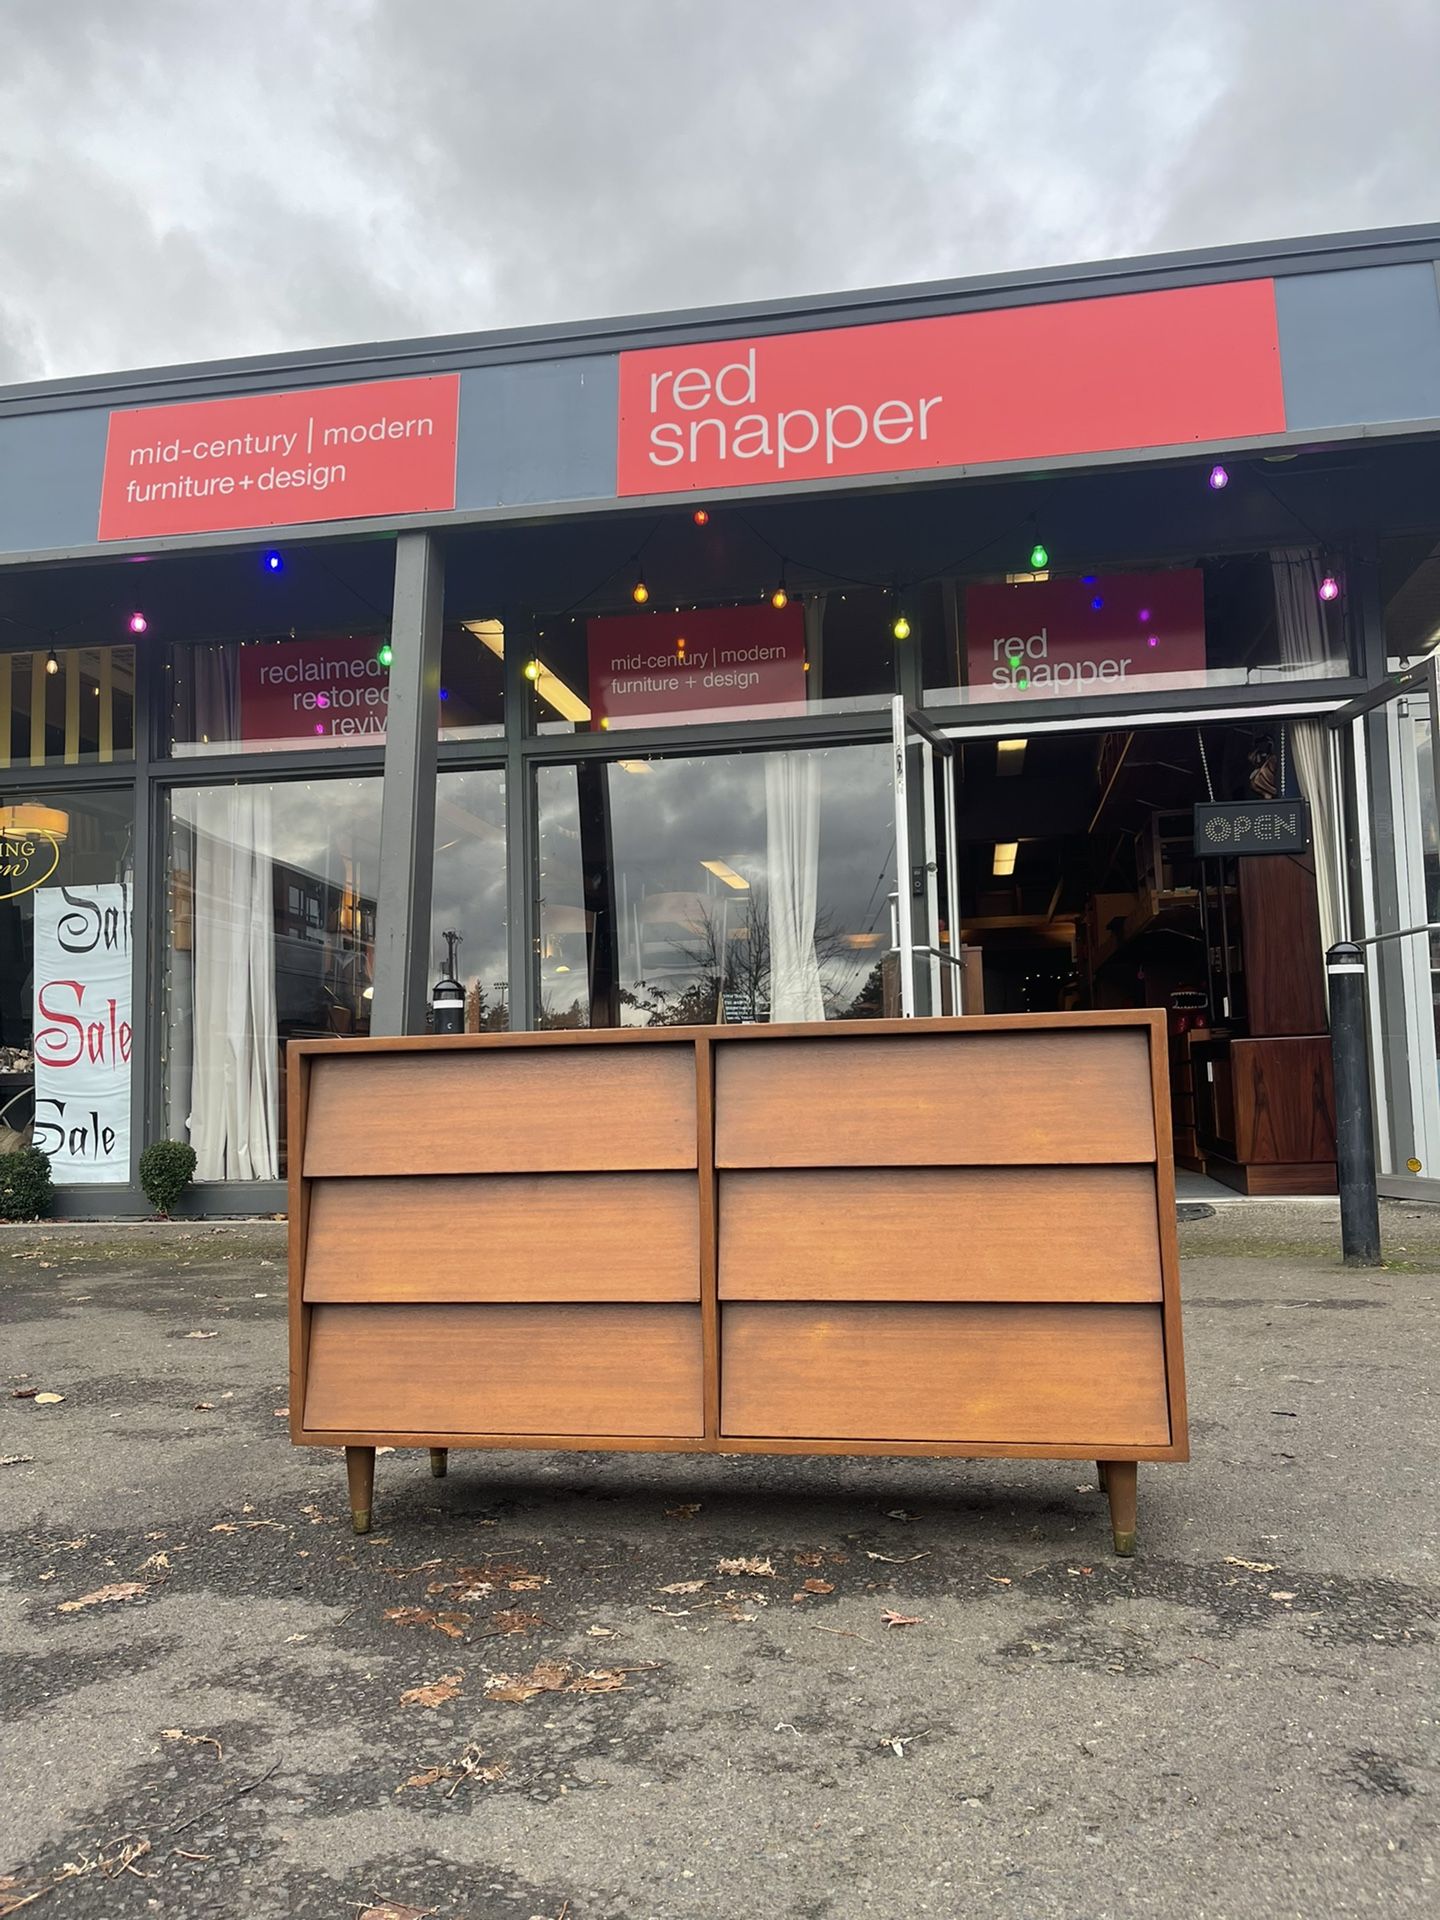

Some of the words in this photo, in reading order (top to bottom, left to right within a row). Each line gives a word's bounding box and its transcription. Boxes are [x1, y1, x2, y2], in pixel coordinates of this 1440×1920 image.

[649, 347, 756, 413] red
[128, 430, 298, 467] mid-century
[322, 415, 434, 447] modern
[648, 395, 944, 469] snapper
[610, 652, 709, 672] mid-century
[720, 645, 787, 664] modern
[992, 627, 1048, 661] red
[610, 675, 680, 695] furniture
[702, 670, 760, 690] design
[991, 657, 1133, 695] snapper
[1204, 812, 1297, 843] OPEN
[57, 883, 134, 959] Sal
[34, 980, 134, 1073] Sale
